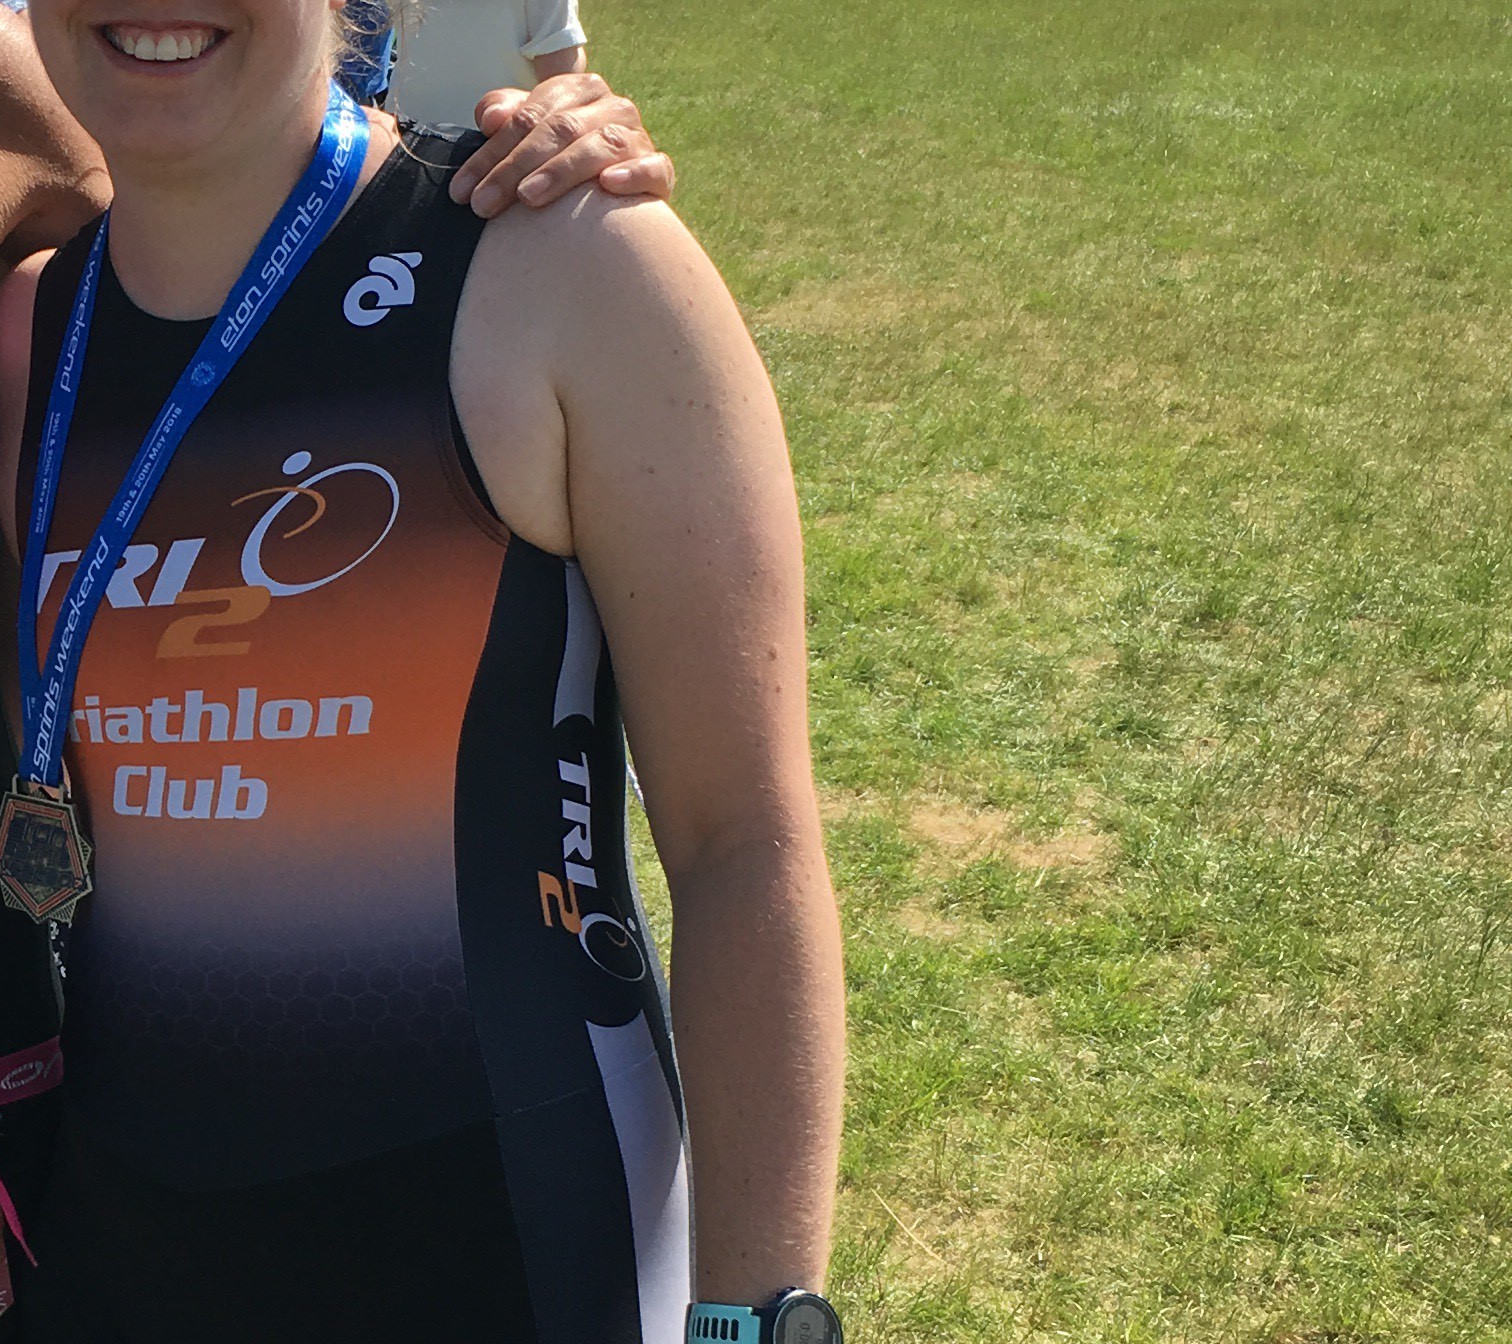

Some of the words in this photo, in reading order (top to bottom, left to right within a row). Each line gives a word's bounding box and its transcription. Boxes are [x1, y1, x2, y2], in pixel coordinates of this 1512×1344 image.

[220, 285, 262, 352] eton
[261, 192, 324, 279] sprints
[60, 259, 97, 393] weekend
[149, 435, 166, 460] May
[32, 675, 61, 768] sprints
[54, 535, 110, 674] weekend
[156, 585, 271, 658] 2
[68, 687, 373, 744] riathlon
[112, 764, 269, 820] Club
[558, 751, 599, 889] TRI
